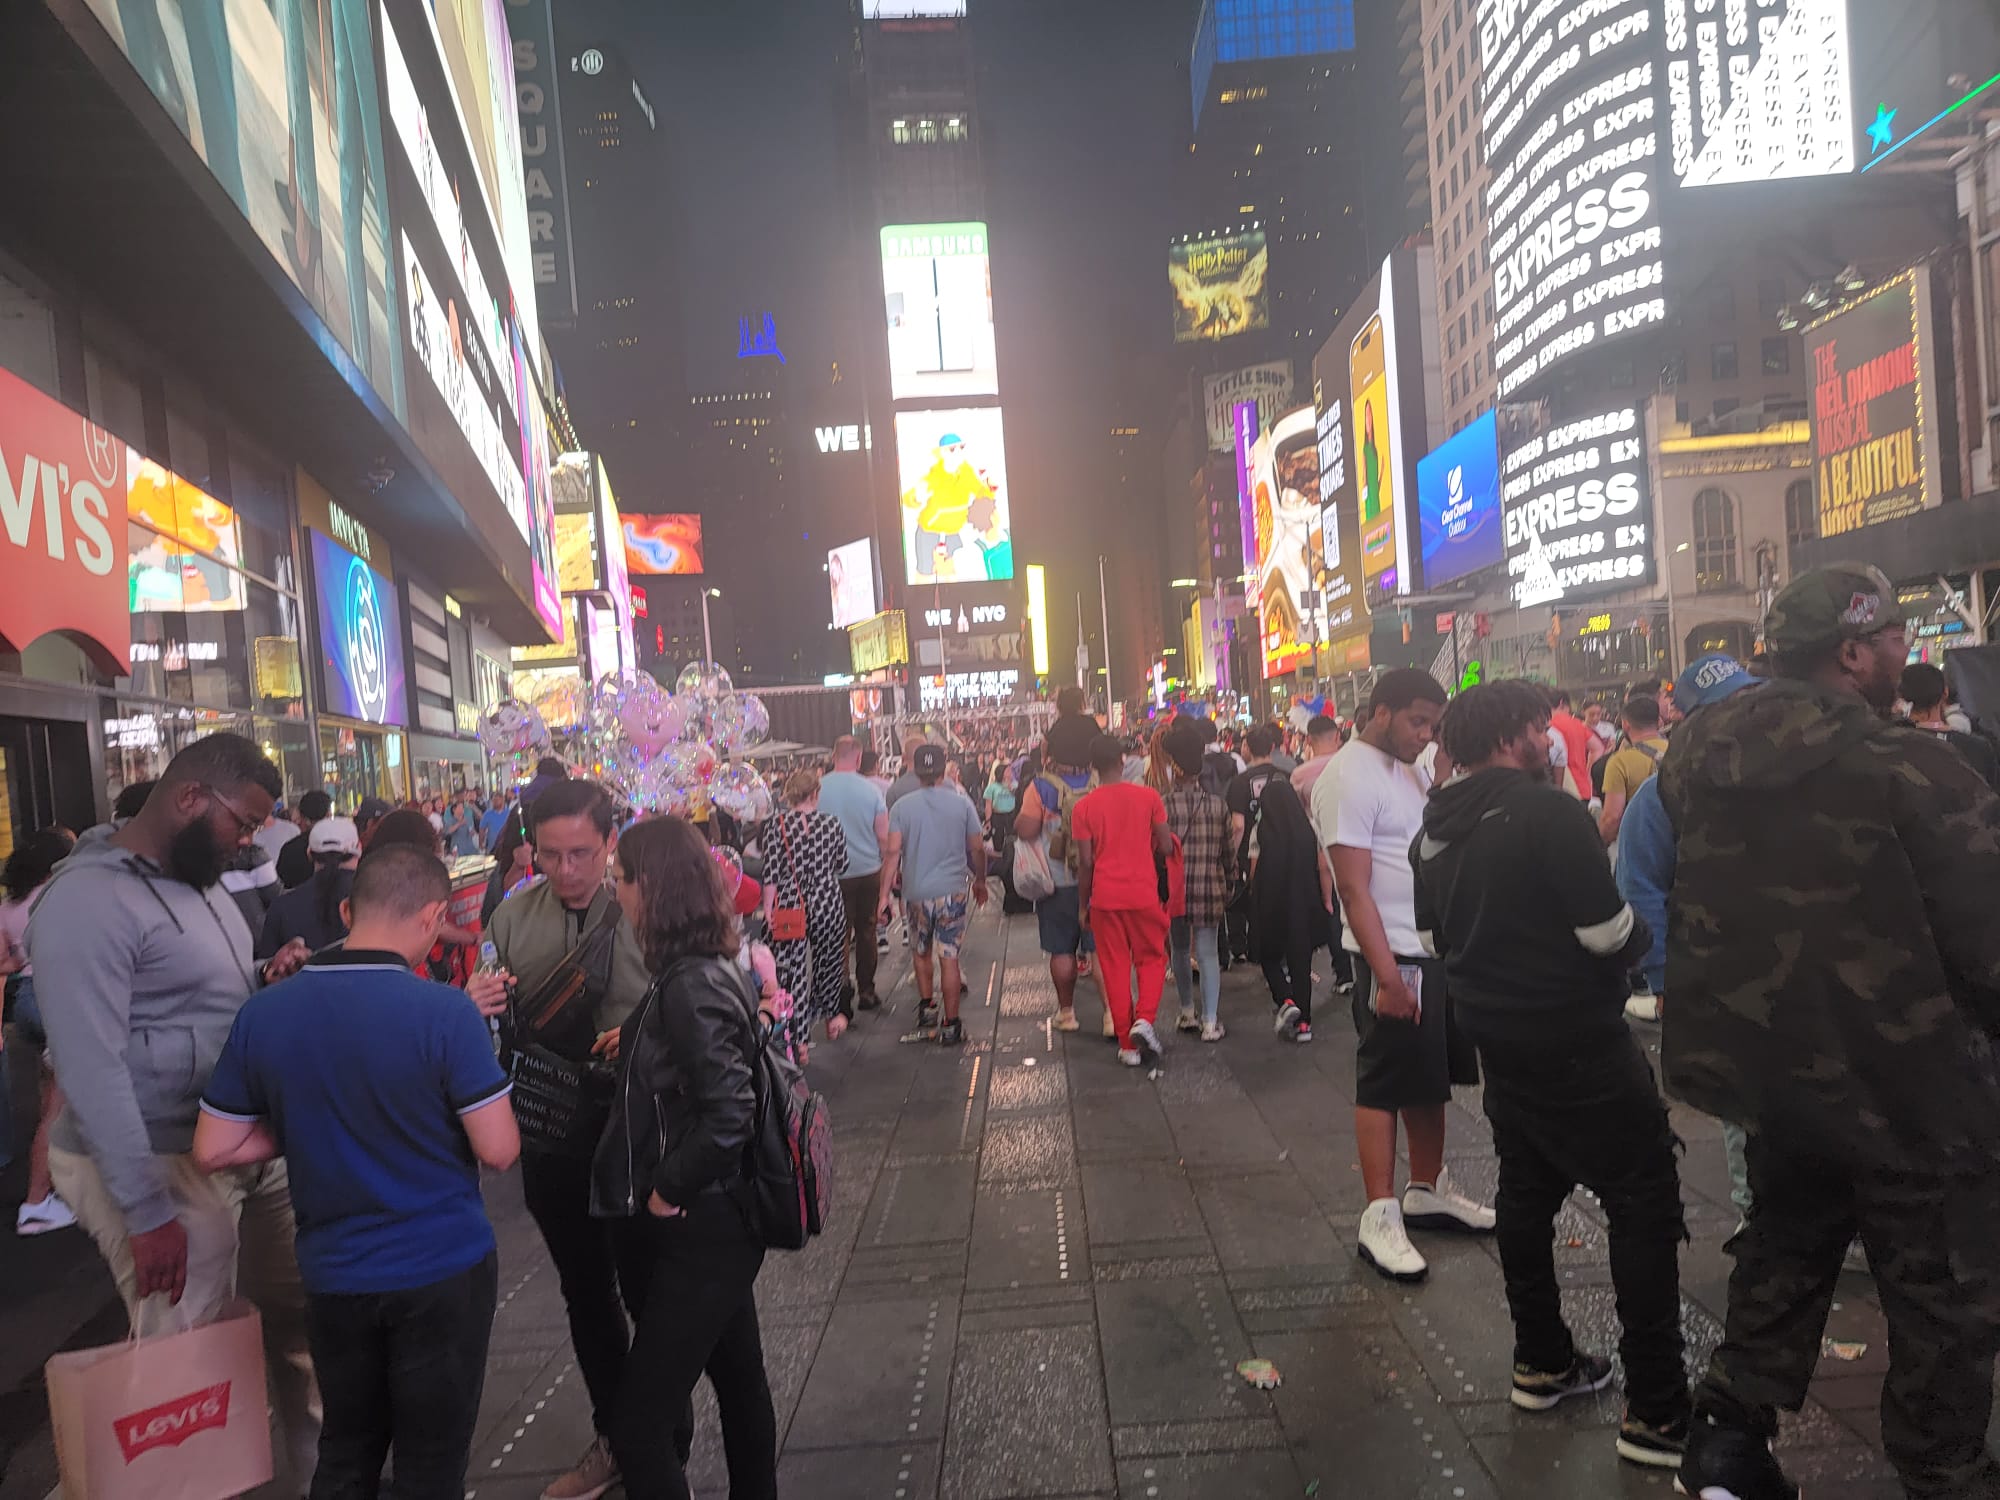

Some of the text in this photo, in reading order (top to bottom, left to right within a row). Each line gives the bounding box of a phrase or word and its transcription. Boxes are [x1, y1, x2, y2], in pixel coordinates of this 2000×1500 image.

[1588, 9, 1650, 57] EXPR
[1529, 128, 1585, 190] EXPRESS
[1593, 96, 1654, 142] EXPR
[1667, 60, 1694, 176] EXPRESS
[1494, 171, 1650, 313] EXPRESS
[1535, 252, 1592, 305] EXPRESS
[1600, 226, 1661, 267] EXPR
[1524, 299, 1567, 347] EXPRESS
[1539, 321, 1595, 369] EXPRESS
[1603, 298, 1665, 337] EXPR
[814, 424, 860, 453] WE
[1317, 421, 1344, 474] TIMES
[1506, 435, 1544, 474] EXPRESS
[1546, 408, 1636, 453] EXPRESS
[1817, 402, 1873, 456] MUSICAL
[1320, 457, 1345, 503] SQUARE
[1532, 447, 1600, 487] EXPRESS
[1609, 437, 1640, 464] EX
[1819, 459, 1831, 512] A
[1831, 426, 1919, 508] BEAUTIFUL
[1505, 472, 1640, 549] EXPRESS
[1614, 523, 1646, 549] EX
[1556, 553, 1645, 589] EXPRESS
[925, 608, 952, 627] WE
[557, 1068, 580, 1088] YOU
